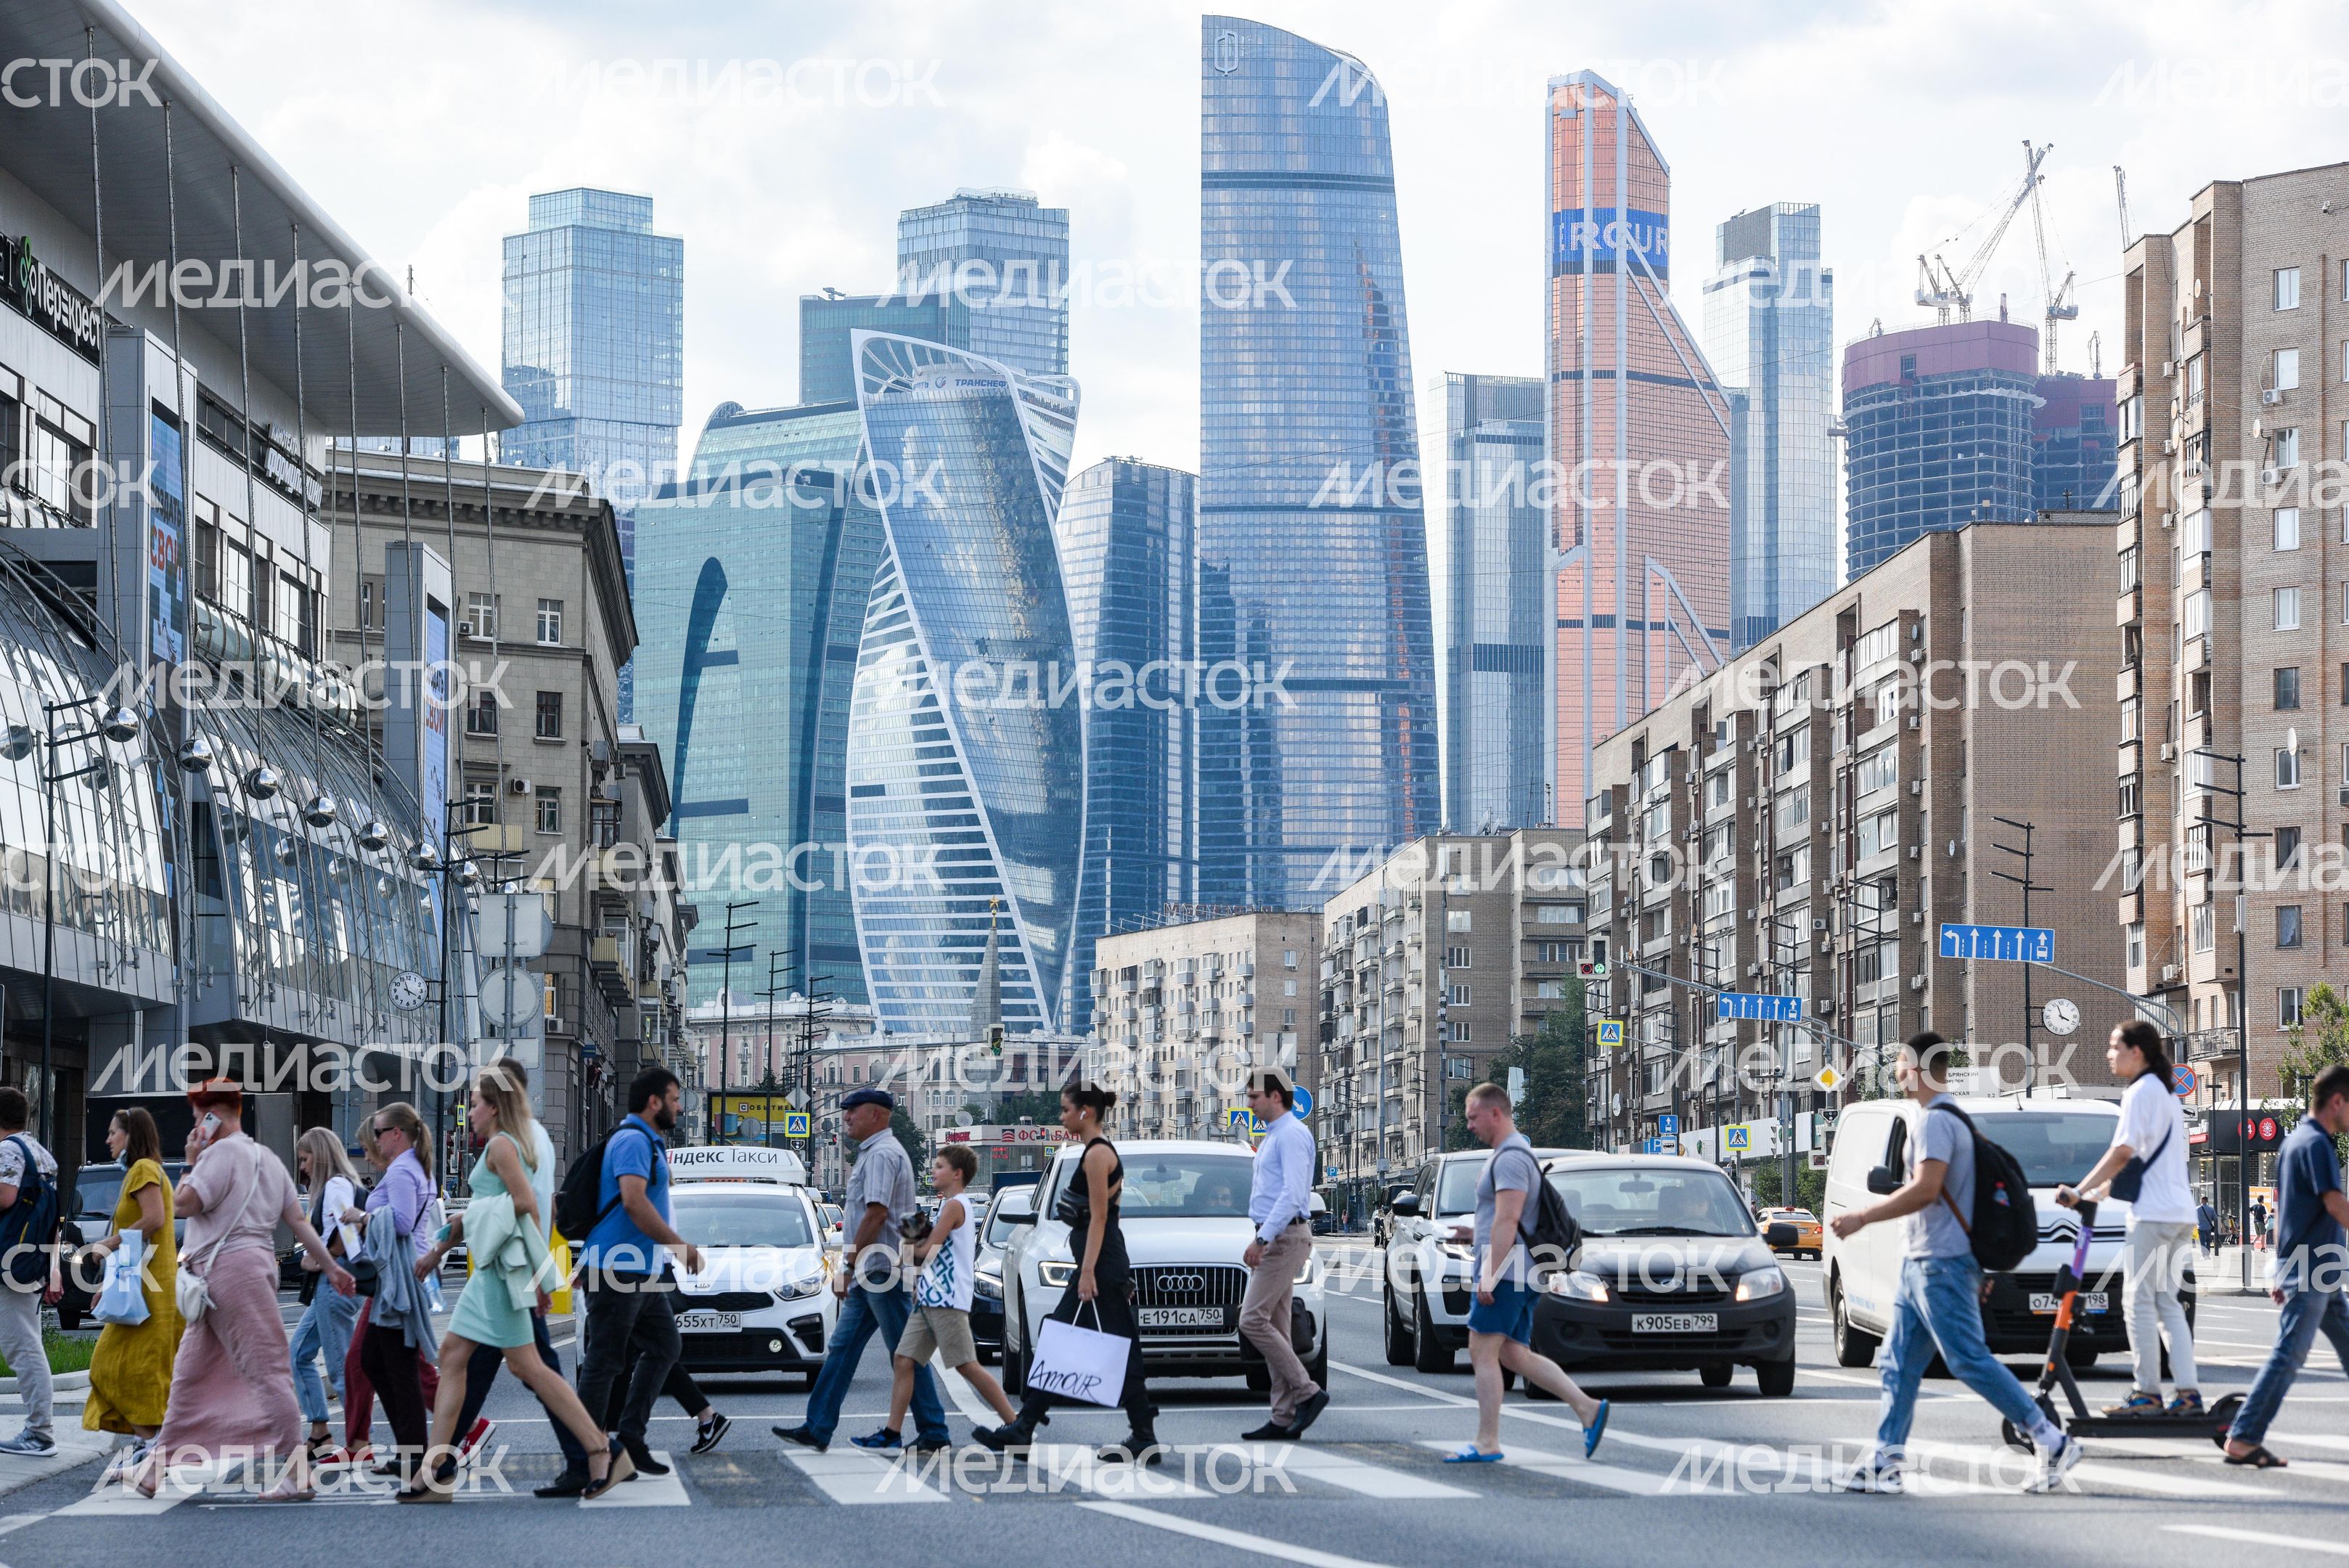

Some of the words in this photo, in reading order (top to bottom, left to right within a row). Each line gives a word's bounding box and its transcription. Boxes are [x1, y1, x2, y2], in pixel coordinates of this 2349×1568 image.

[1553, 220, 1668, 256] ERCUR
[955, 378, 1008, 388] ТРАНСНЕФ
[729, 1148, 777, 1164] Такси
[2088, 1294, 2105, 1304] 198
[718, 1315, 737, 1324] 750
[1143, 1310, 1196, 1324] Е191СА
[1199, 1309, 1220, 1320] 750
[1637, 1316, 1691, 1330] К905ЕВ
[1694, 1315, 1714, 1326] 799
